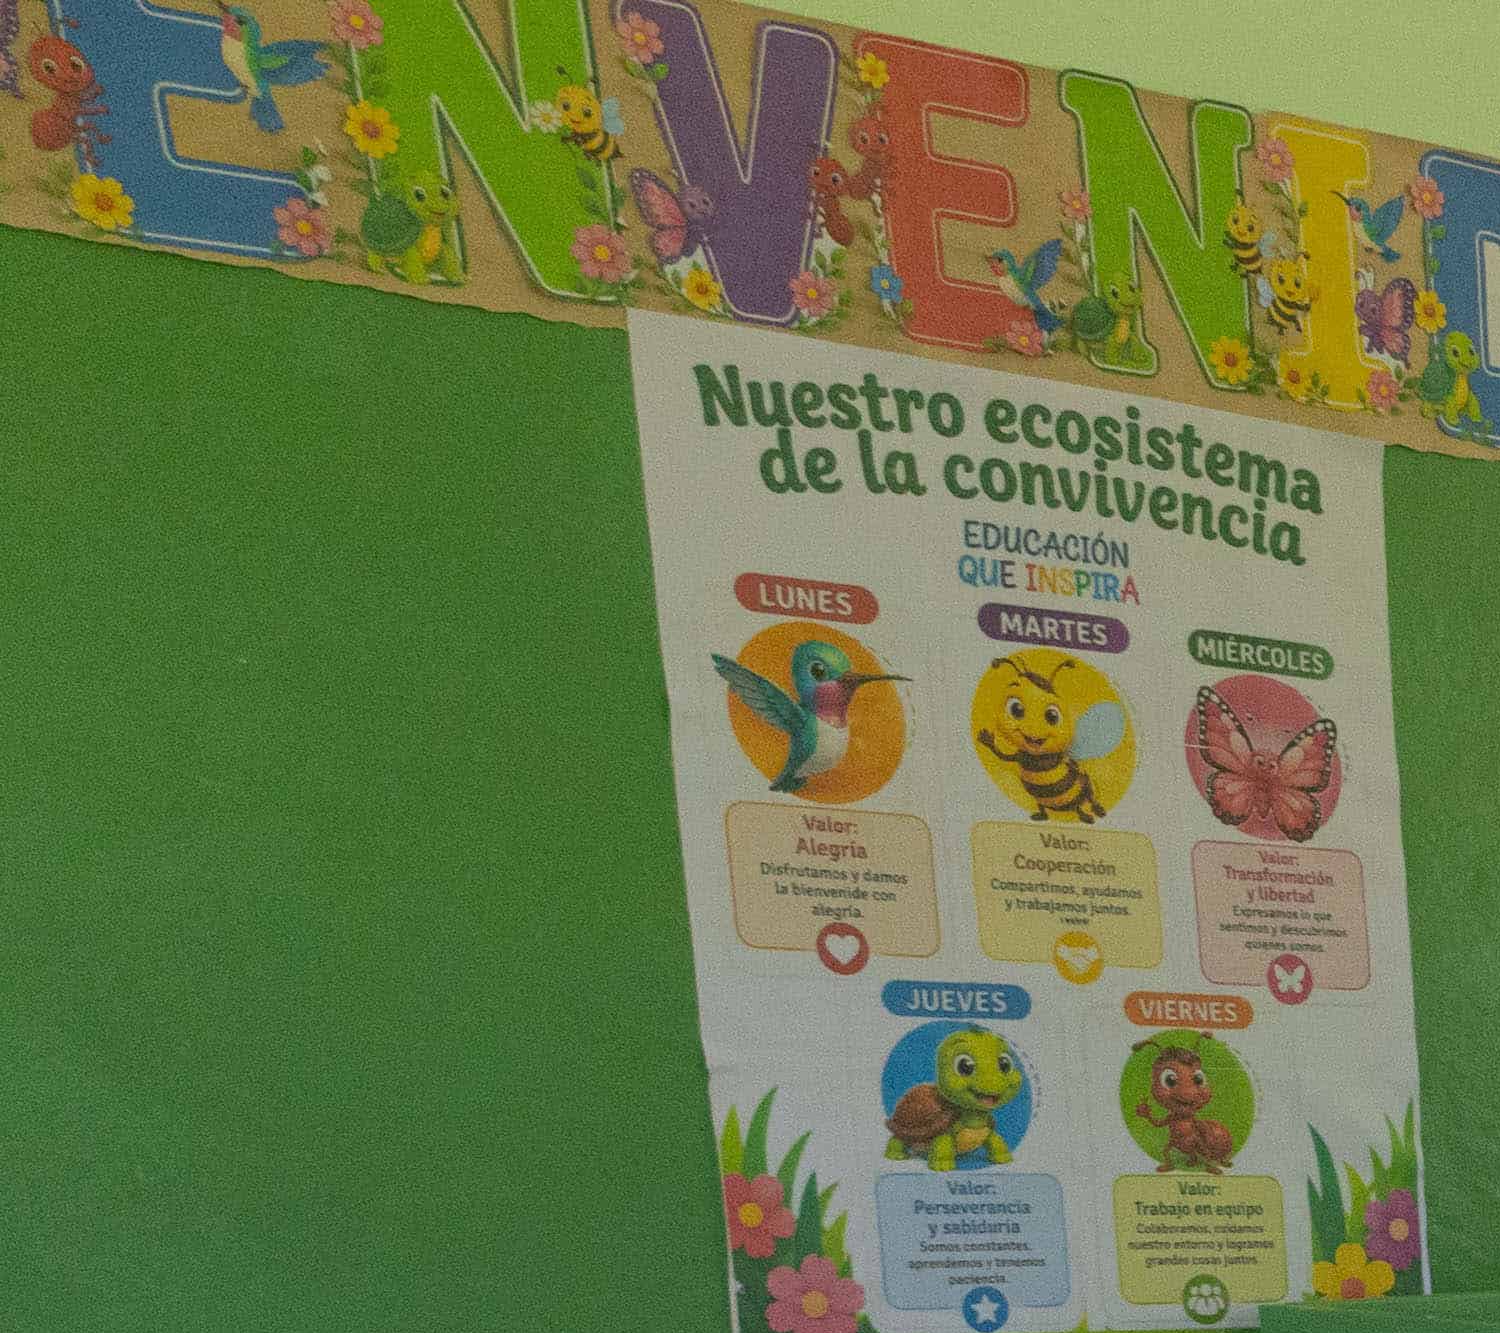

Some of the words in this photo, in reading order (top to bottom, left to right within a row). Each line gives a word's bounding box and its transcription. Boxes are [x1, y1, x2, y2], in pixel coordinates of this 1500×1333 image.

[694, 363, 967, 439] Nuestro
[984, 397, 1324, 514] ecosistema
[760, 427, 843, 496] de
[862, 430, 927, 497] la
[944, 451, 1306, 566] convivencia
[964, 519, 1130, 568] EDUCACIÓN
[958, 556, 1017, 591] QUE
[1025, 561, 1139, 604] INSPIRA
[759, 582, 854, 617] LUNES
[1000, 612, 1108, 647] MARTES
[1196, 637, 1325, 675] MIÉRCOLES
[802, 815, 858, 835] Valor:
[796, 837, 868, 862] Alegría
[1040, 832, 1090, 852] Valor:
[1013, 854, 1117, 877] Cooperación
[1223, 864, 1335, 887] Transformación
[851, 871, 861, 884] y
[1247, 889, 1255, 904] y
[1259, 886, 1316, 904] libertad
[907, 990, 1008, 1013] JUEVES
[1139, 998, 1238, 1023] VIERNES
[946, 1181, 997, 1197] Valor:
[913, 1199, 1032, 1216] Perseverancia
[1135, 1200, 1191, 1219] Trabajo
[1194, 1206, 1213, 1217] en
[1216, 1203, 1265, 1220] equipo
[928, 1223, 939, 1239] y
[943, 1220, 1021, 1236] sabiduría
